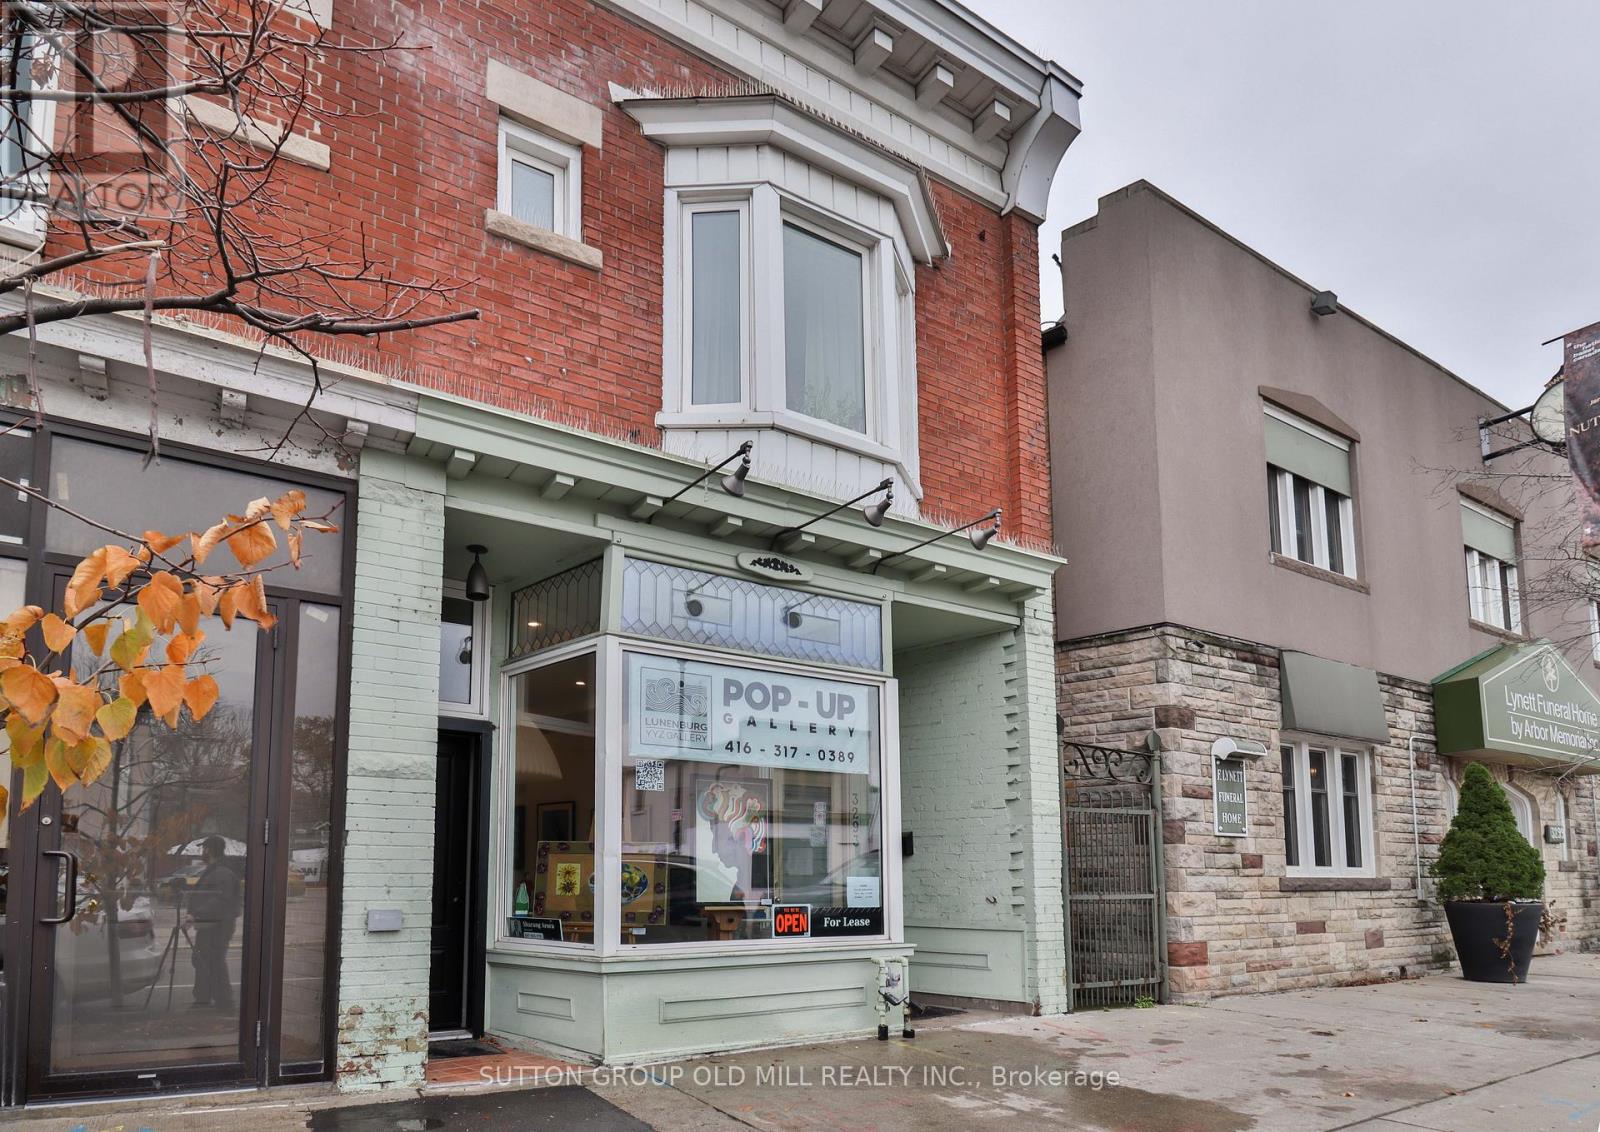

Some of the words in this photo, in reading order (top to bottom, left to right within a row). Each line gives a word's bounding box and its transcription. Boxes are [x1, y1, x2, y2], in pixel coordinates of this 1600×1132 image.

[723, 678, 791, 712] POP
[816, 690, 855, 720] UP
[1505, 684, 1536, 712] Lynett
[1537, 694, 1571, 720] Funeral
[1572, 703, 1598, 727] Home
[645, 717, 708, 731] LUNENBURG
[723, 713, 854, 737] GALLERY
[1511, 716, 1522, 739] by
[1525, 719, 1548, 741] Arbor
[725, 740, 752, 754] 416
[774, 744, 798, 758] 317
[818, 749, 855, 763] 0389
[1219, 791, 1244, 803] FUNERAL
[1222, 812, 1242, 824] HOME
[775, 913, 807, 933] OPEN
[824, 917, 841, 927] For
[843, 917, 871, 927] Lease
